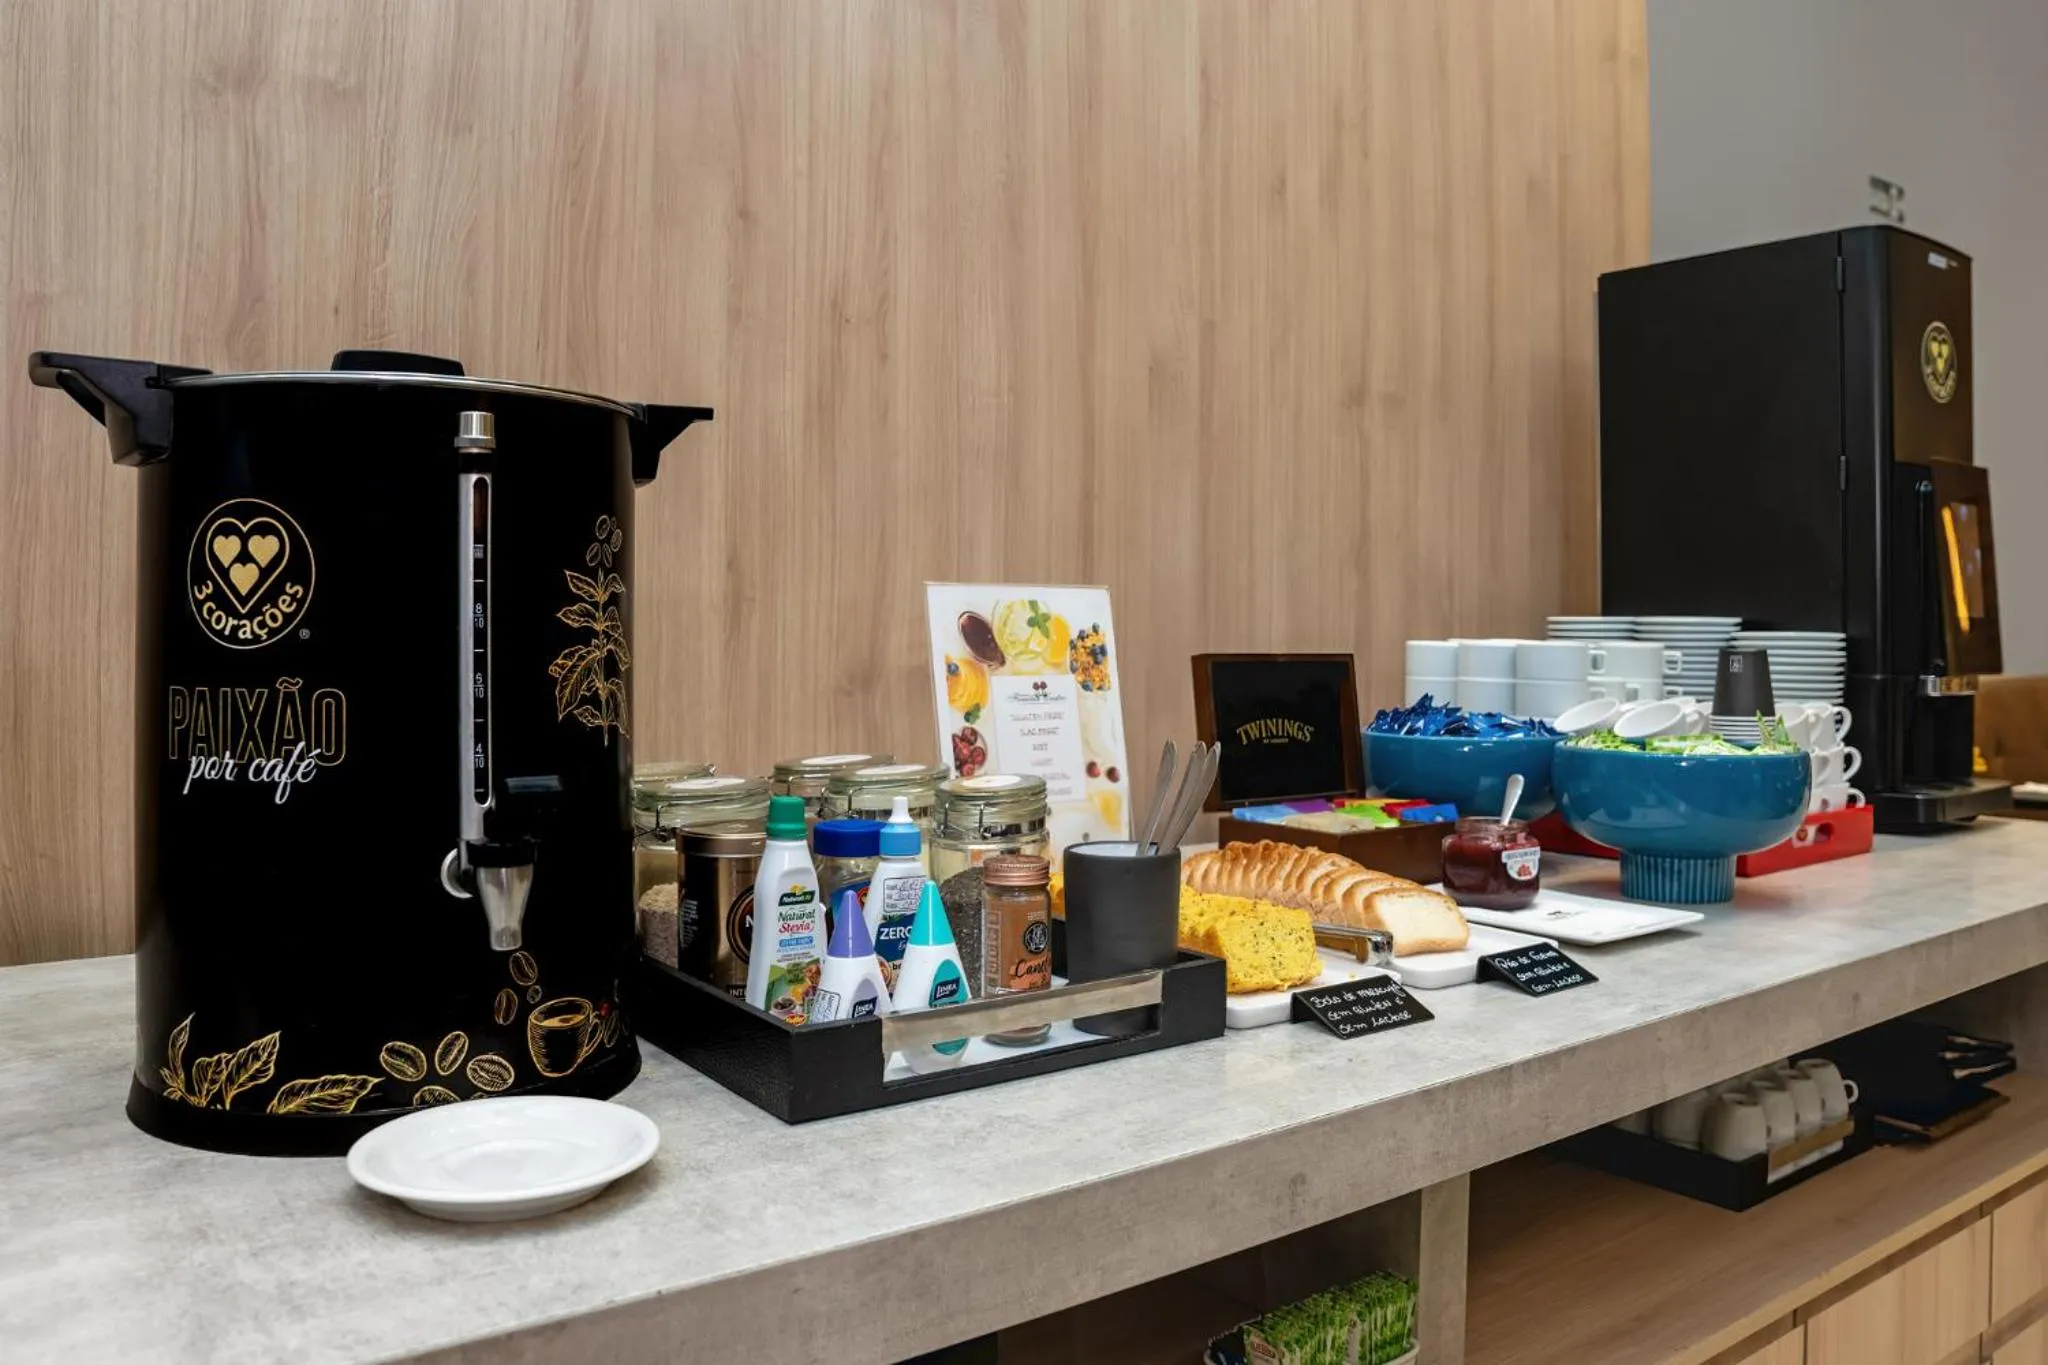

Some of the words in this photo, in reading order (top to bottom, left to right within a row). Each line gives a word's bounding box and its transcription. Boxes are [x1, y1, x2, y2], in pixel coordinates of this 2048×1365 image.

[194, 580, 214, 600] 3
[202, 582, 304, 640] corações
[168, 676, 347, 767] PAIXÃO
[1236, 718, 1312, 745] TWININGS
[183, 751, 239, 795] por
[248, 741, 322, 804] café
[778, 920, 812, 934] Stevia
